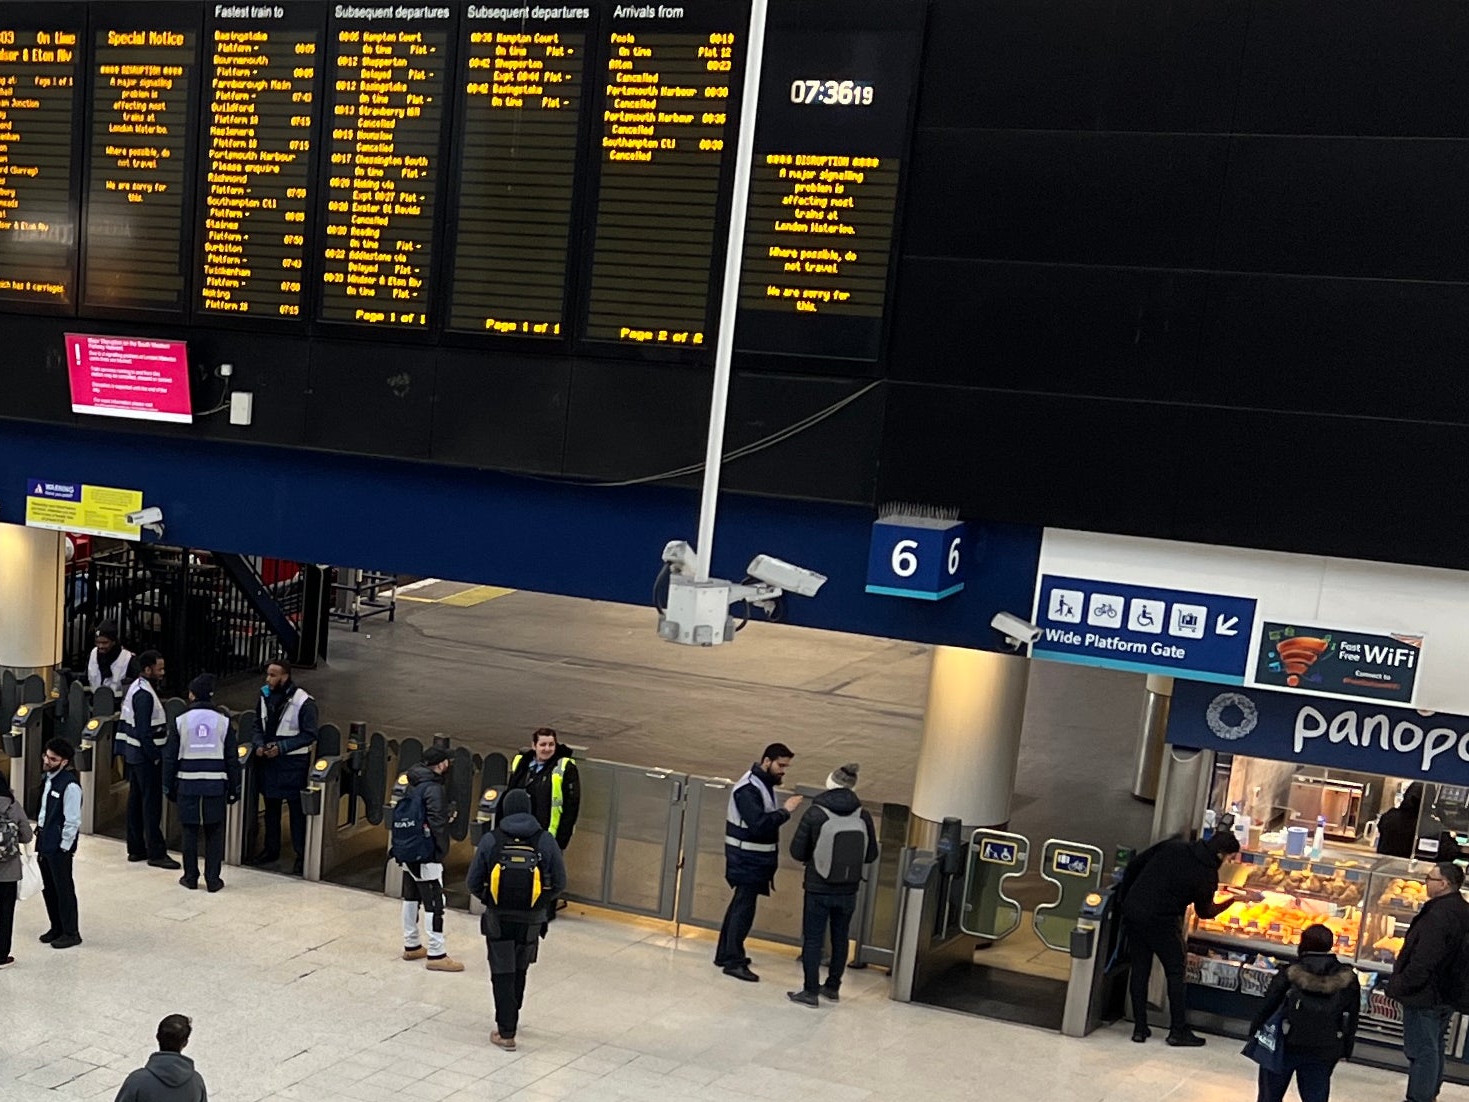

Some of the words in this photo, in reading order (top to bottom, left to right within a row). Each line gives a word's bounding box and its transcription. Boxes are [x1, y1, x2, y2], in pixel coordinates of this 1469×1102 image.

[215, 5, 249, 18] Fastest
[252, 6, 272, 18] train
[274, 6, 284, 18] to
[335, 5, 393, 21] Subsequent
[395, 5, 449, 21] departures
[467, 5, 529, 21] Subsequent
[532, 5, 590, 21] departures
[613, 5, 655, 18] Arrivals
[658, 5, 684, 18] from
[37, 31, 50, 45] On
[55, 31, 76, 45] time
[108, 31, 145, 46] Special
[149, 31, 185, 46] Notice
[779, 168, 786, 179] A
[789, 170, 816, 181] major
[794, 183, 833, 195] problem
[782, 196, 828, 208] affecting
[774, 220, 808, 233] London
[783, 287, 800, 298] are
[803, 289, 830, 302] sorry
[833, 290, 850, 300] for
[355, 309, 385, 323] Page
[390, 312, 396, 322] 1
[400, 313, 414, 323] of
[420, 314, 426, 324] 1
[486, 318, 516, 332] Page
[522, 321, 528, 332] 1
[533, 322, 549, 334] of
[554, 323, 560, 334] 1
[620, 328, 653, 342] Page
[658, 330, 668, 341] 2
[673, 332, 688, 343] of
[693, 333, 703, 344] 2
[892, 539, 918, 577] 6
[948, 537, 961, 575] 6
[1045, 628, 1082, 645] Wide
[1085, 633, 1147, 654] Platform
[1151, 642, 1186, 659] Gate
[1339, 650, 1360, 662] Free
[1340, 641, 1361, 652] Fast
[1363, 644, 1415, 668] WiFi
